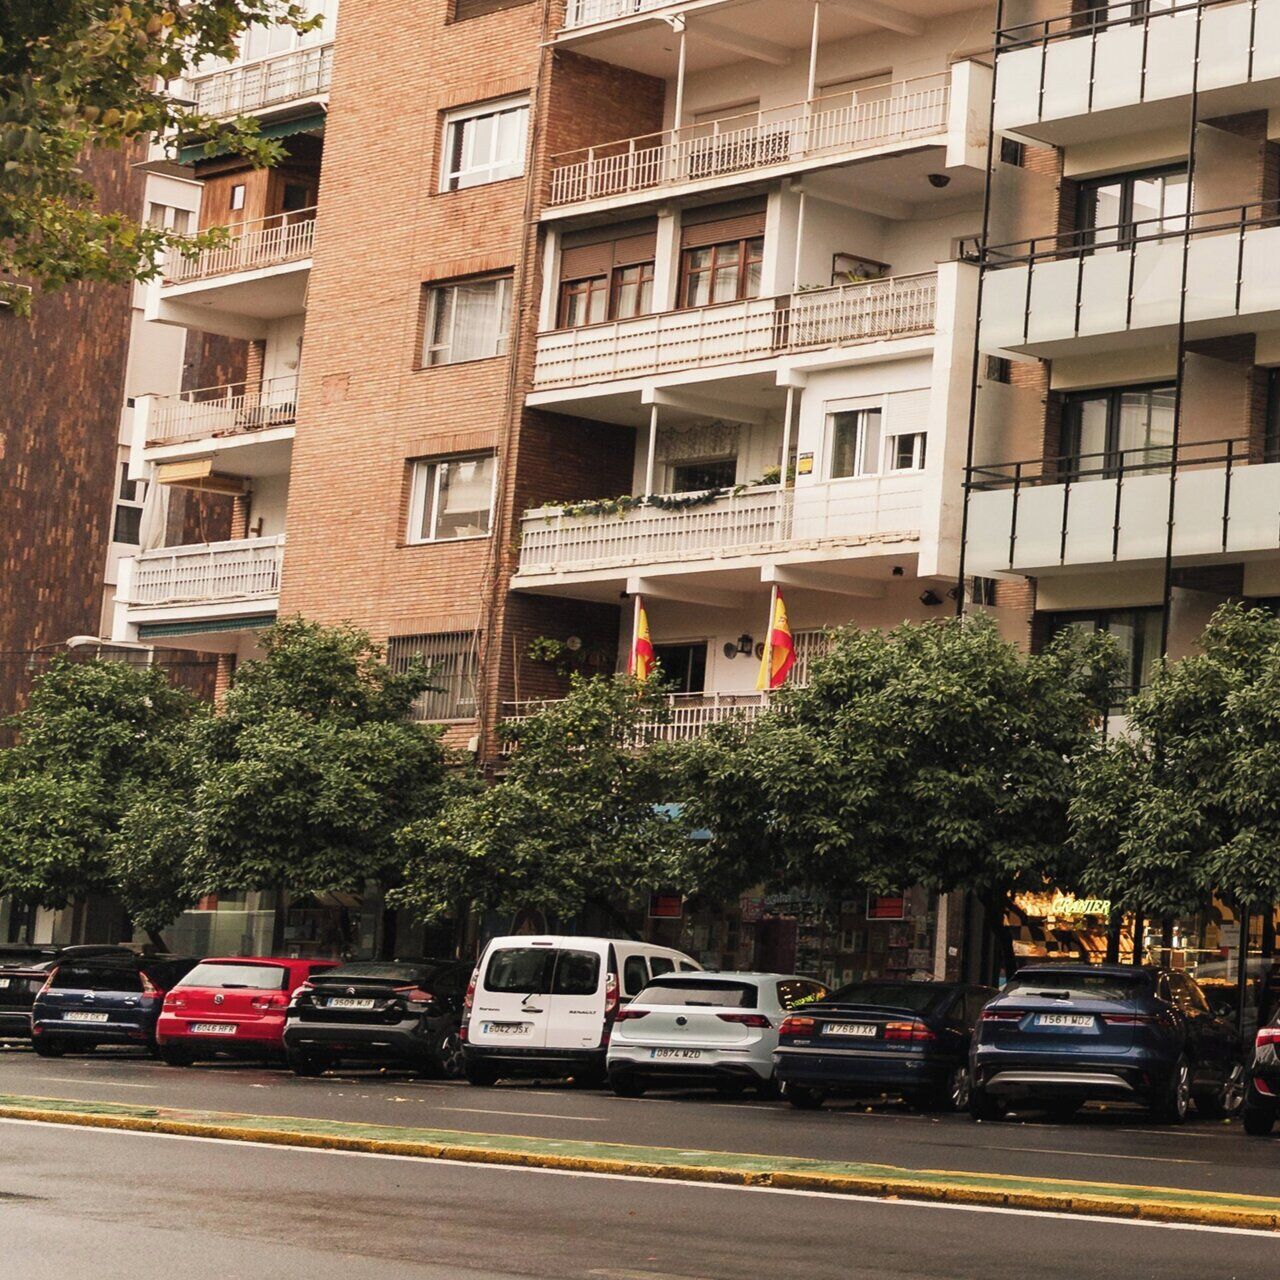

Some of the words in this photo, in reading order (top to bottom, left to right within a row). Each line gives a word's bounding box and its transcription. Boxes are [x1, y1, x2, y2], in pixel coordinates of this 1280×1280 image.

[1052, 898, 1111, 916] GRANIER
[1043, 1015, 1068, 1024] 1561
[489, 1025, 510, 1033] 6042
[512, 1025, 530, 1033] JSX
[656, 1048, 680, 1057] 0874
